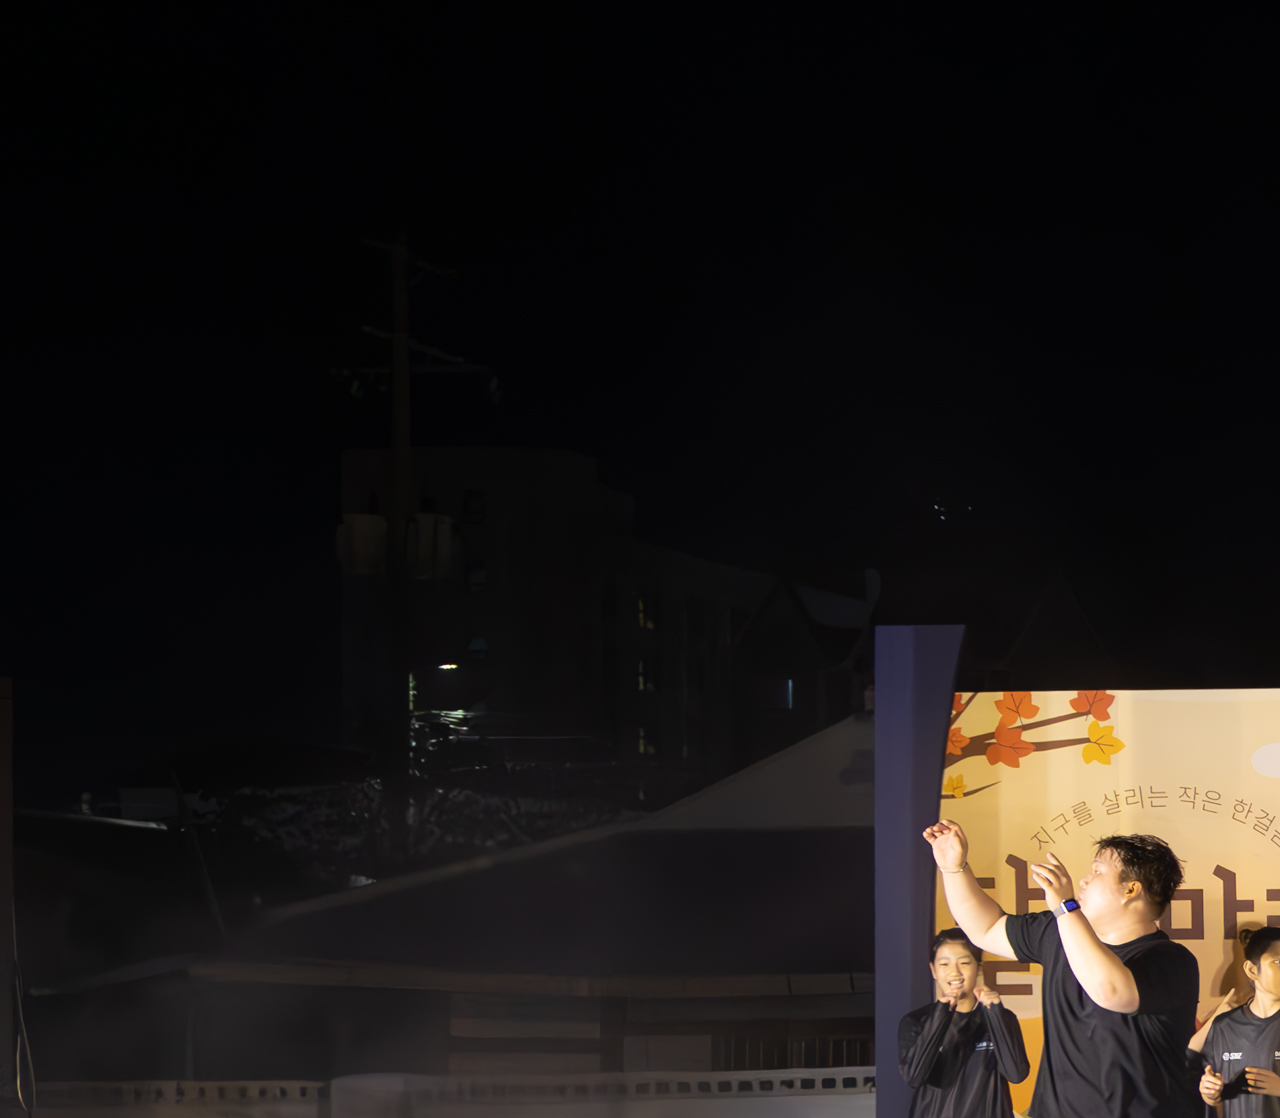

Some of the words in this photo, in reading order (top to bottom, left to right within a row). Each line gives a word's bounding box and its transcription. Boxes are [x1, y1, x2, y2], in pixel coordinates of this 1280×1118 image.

[1029, 800, 1095, 851] 지구를
[1101, 785, 1169, 816] 살리는
[1178, 786, 1222, 814] 작은
